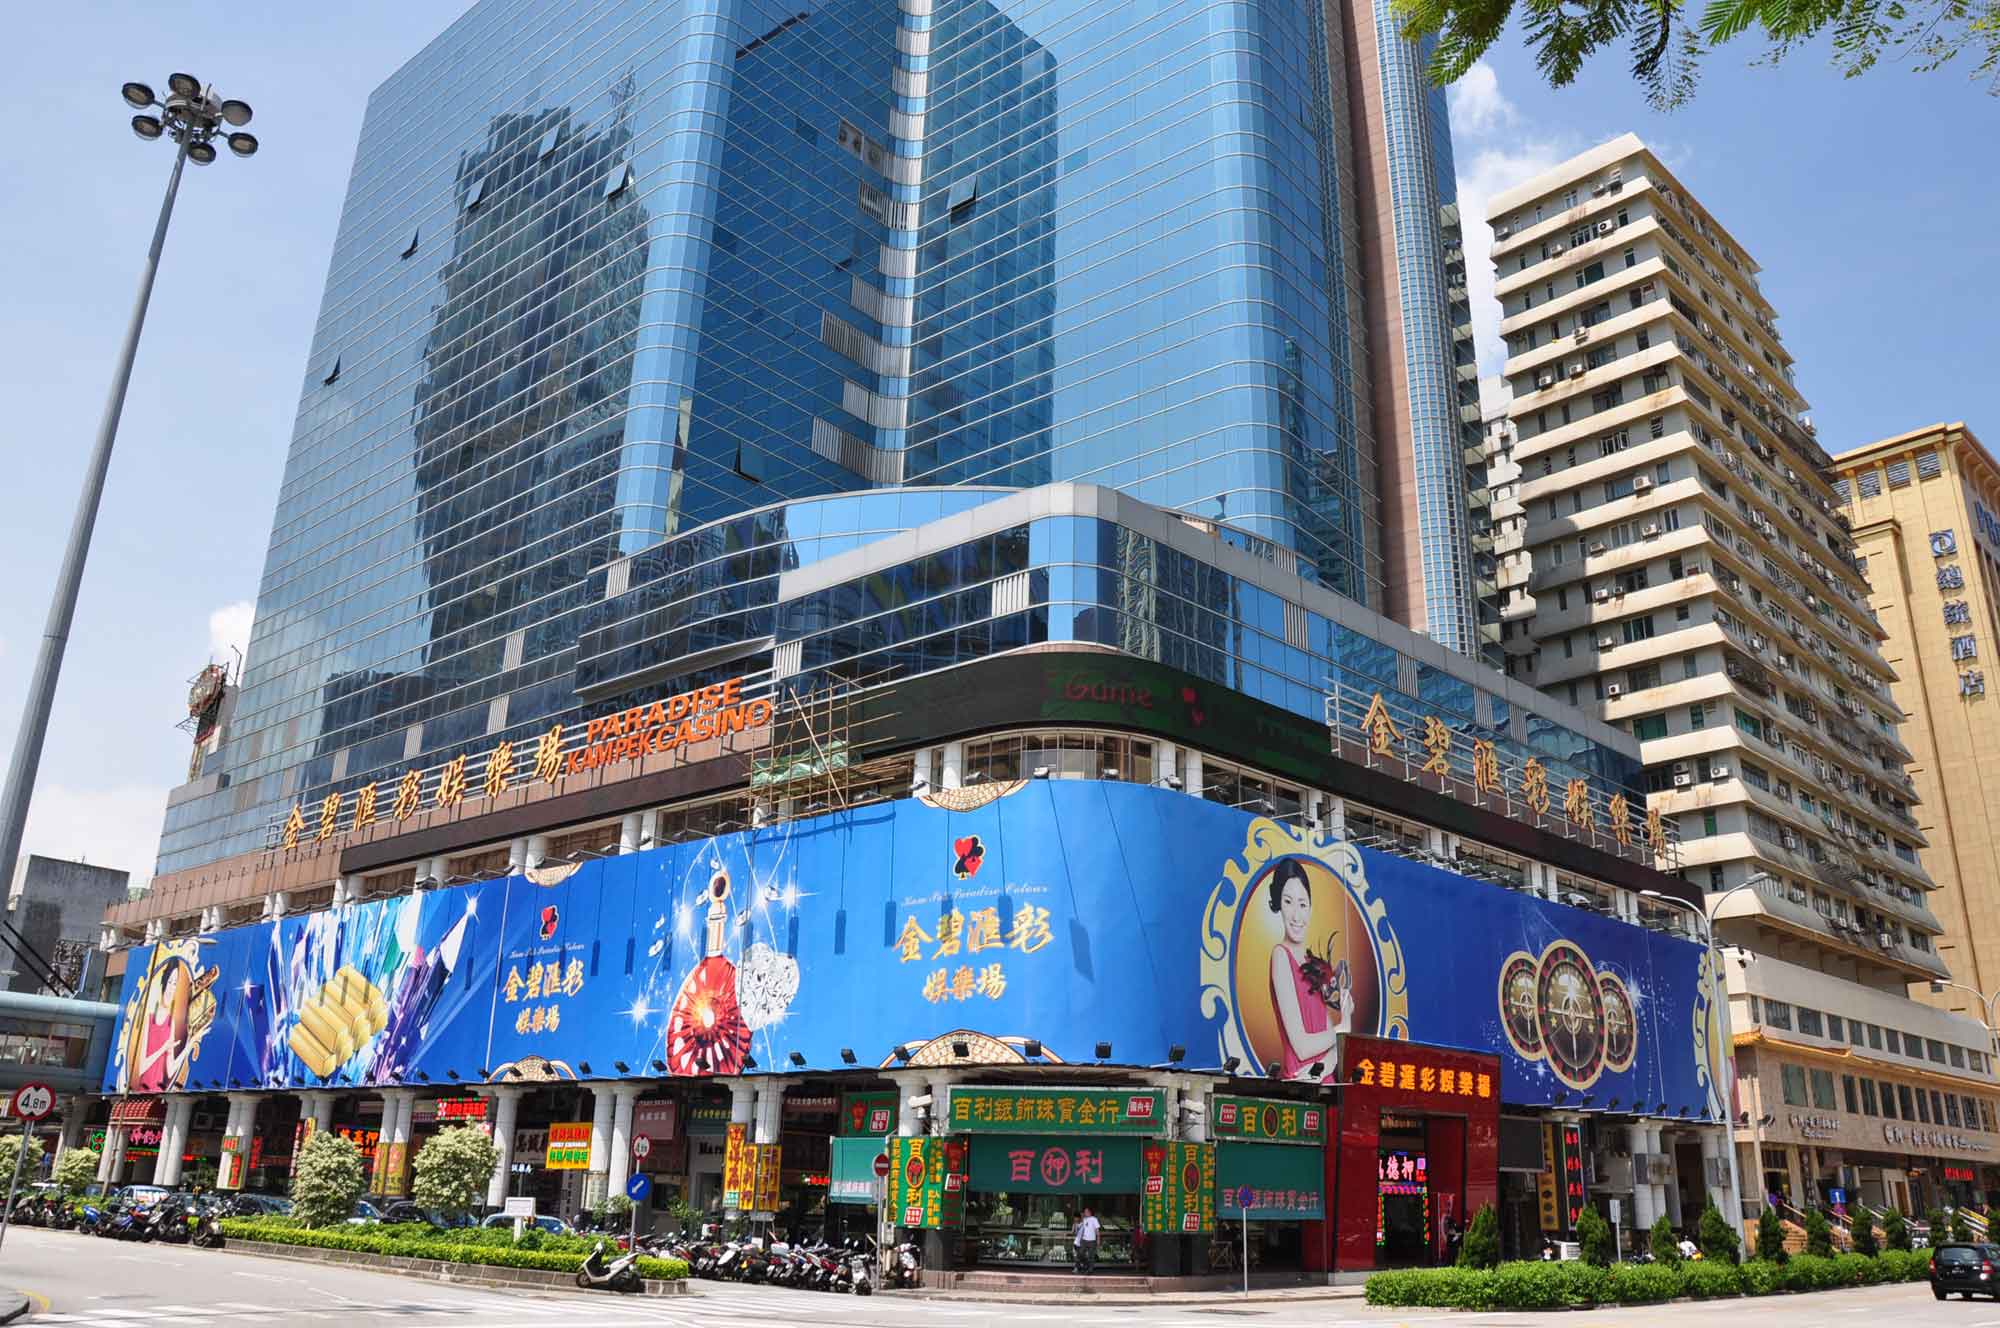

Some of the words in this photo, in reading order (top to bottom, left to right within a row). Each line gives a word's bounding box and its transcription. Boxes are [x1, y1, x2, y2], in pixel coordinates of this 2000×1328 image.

[1936, 565, 1985, 695] 總統酒店
[587, 676, 743, 743] PARADISE
[654, 699, 773, 752] CASINO
